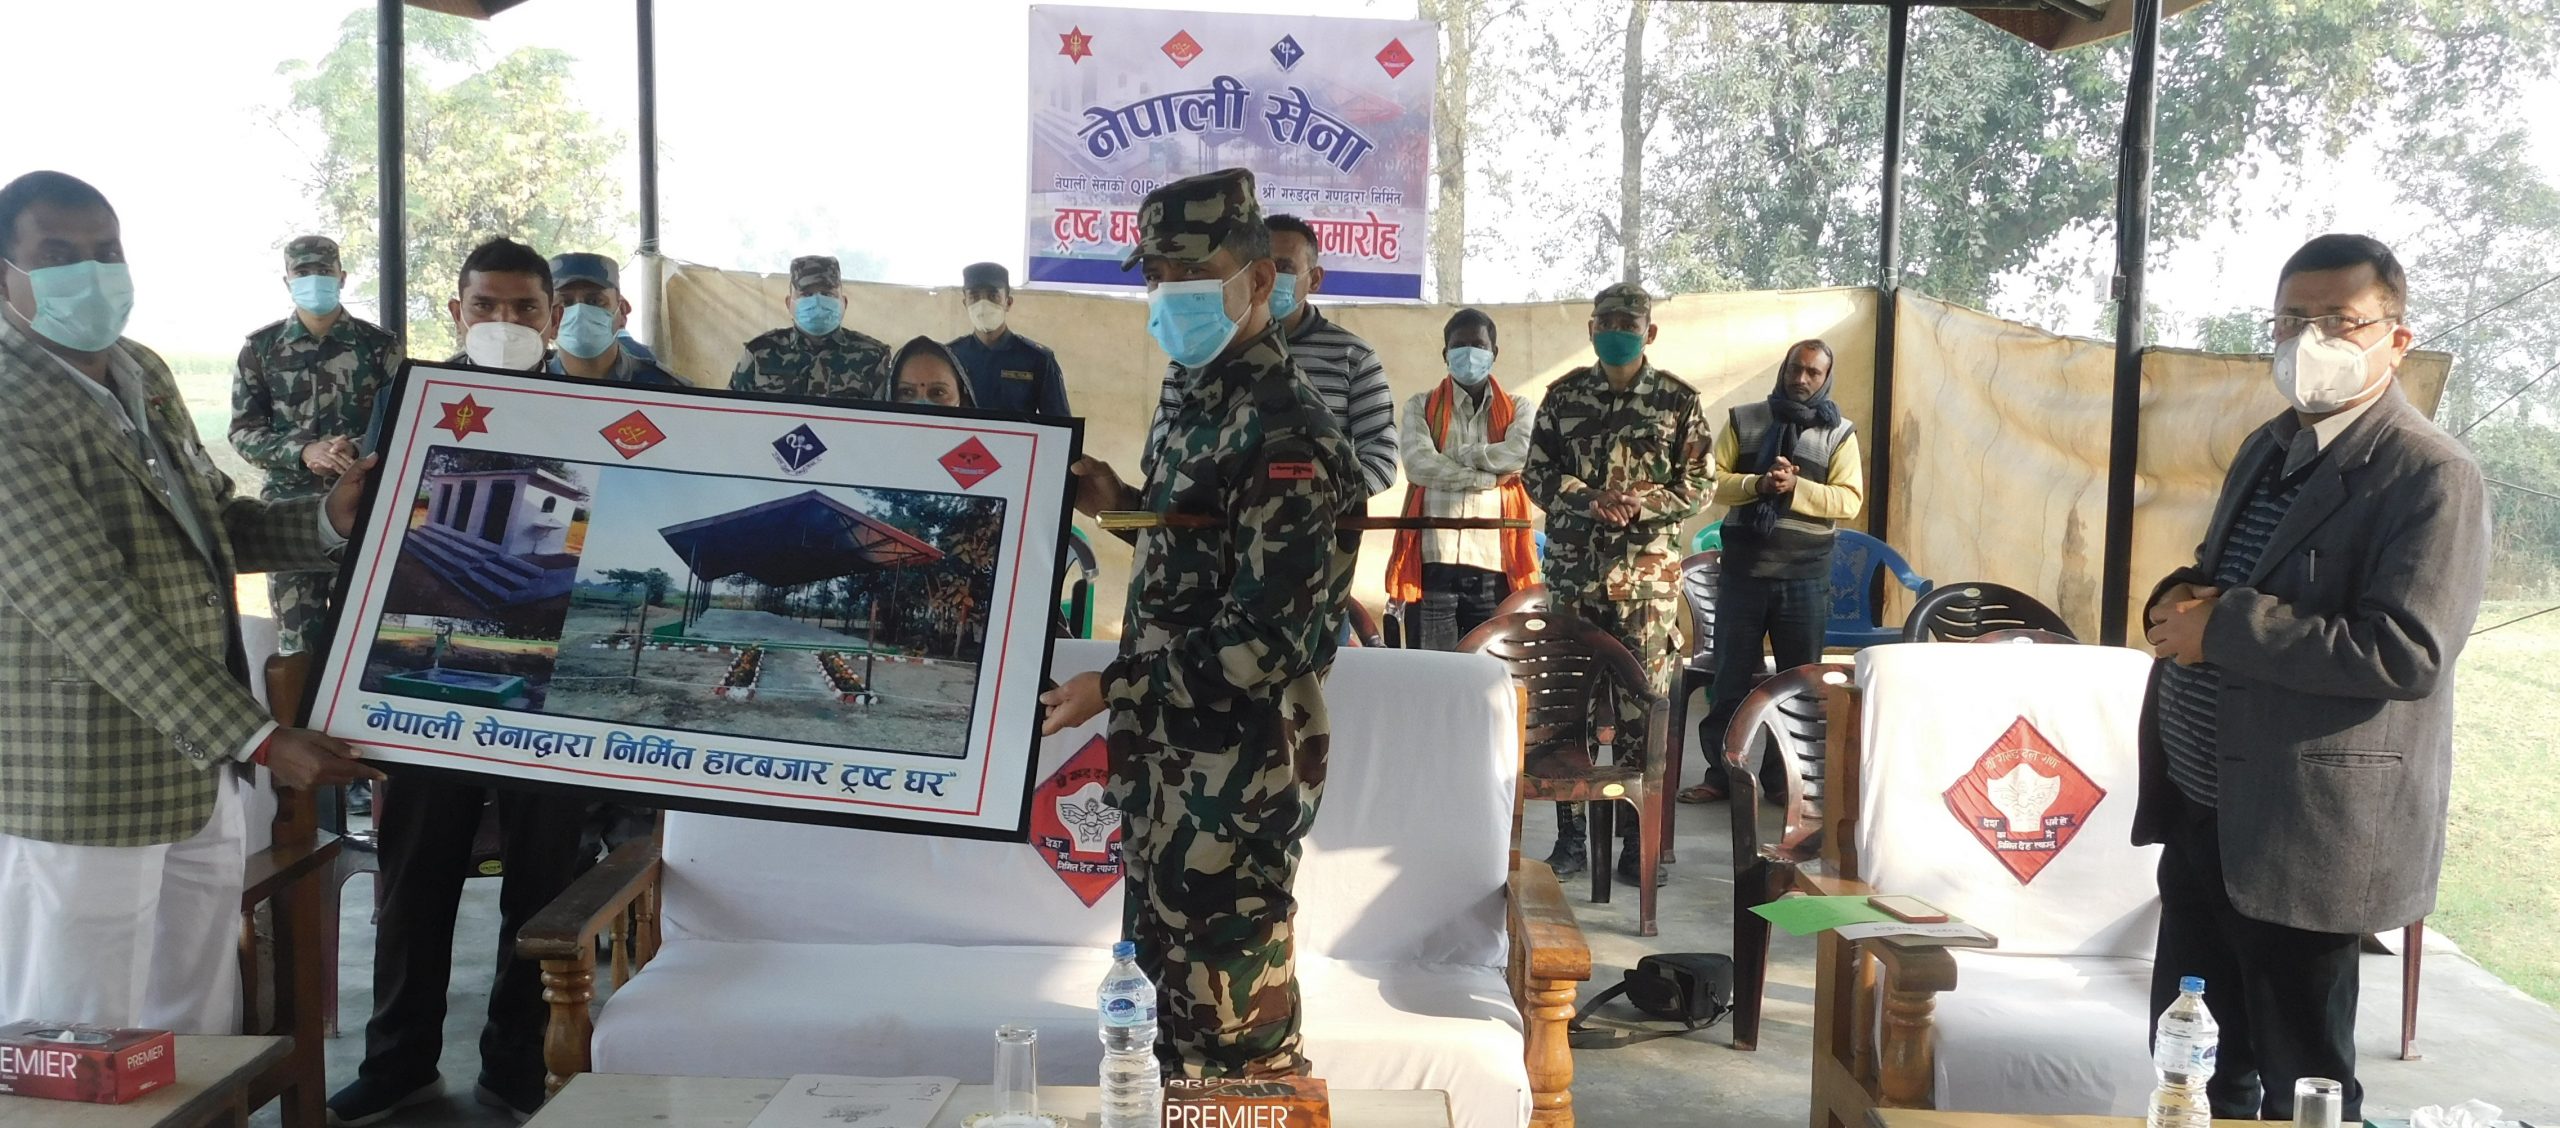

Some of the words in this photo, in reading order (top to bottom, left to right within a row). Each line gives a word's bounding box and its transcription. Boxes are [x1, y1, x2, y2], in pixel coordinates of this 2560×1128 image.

[1077, 75, 1250, 158] नेपाली
[1264, 86, 1375, 174] सेना
[1055, 175, 1086, 190] नेपाली
[1092, 175, 1125, 192] सेनाको
[1263, 184, 1276, 199] श्री
[1281, 187, 1320, 203] गरुडदल
[1325, 189, 1366, 205] गणद्वारा
[1371, 186, 1402, 205] निर्मित
[1055, 208, 1101, 252] ट्रष्ट
[473, 716, 596, 758] सेनाद्वारा
[603, 730, 696, 770] निर्मित
[702, 750, 833, 786] हाटबजार
[840, 764, 896, 793] ट्रष्ट
[127, 1045, 164, 1069] PREMIER
[1166, 1105, 1288, 1128] PREMIER
